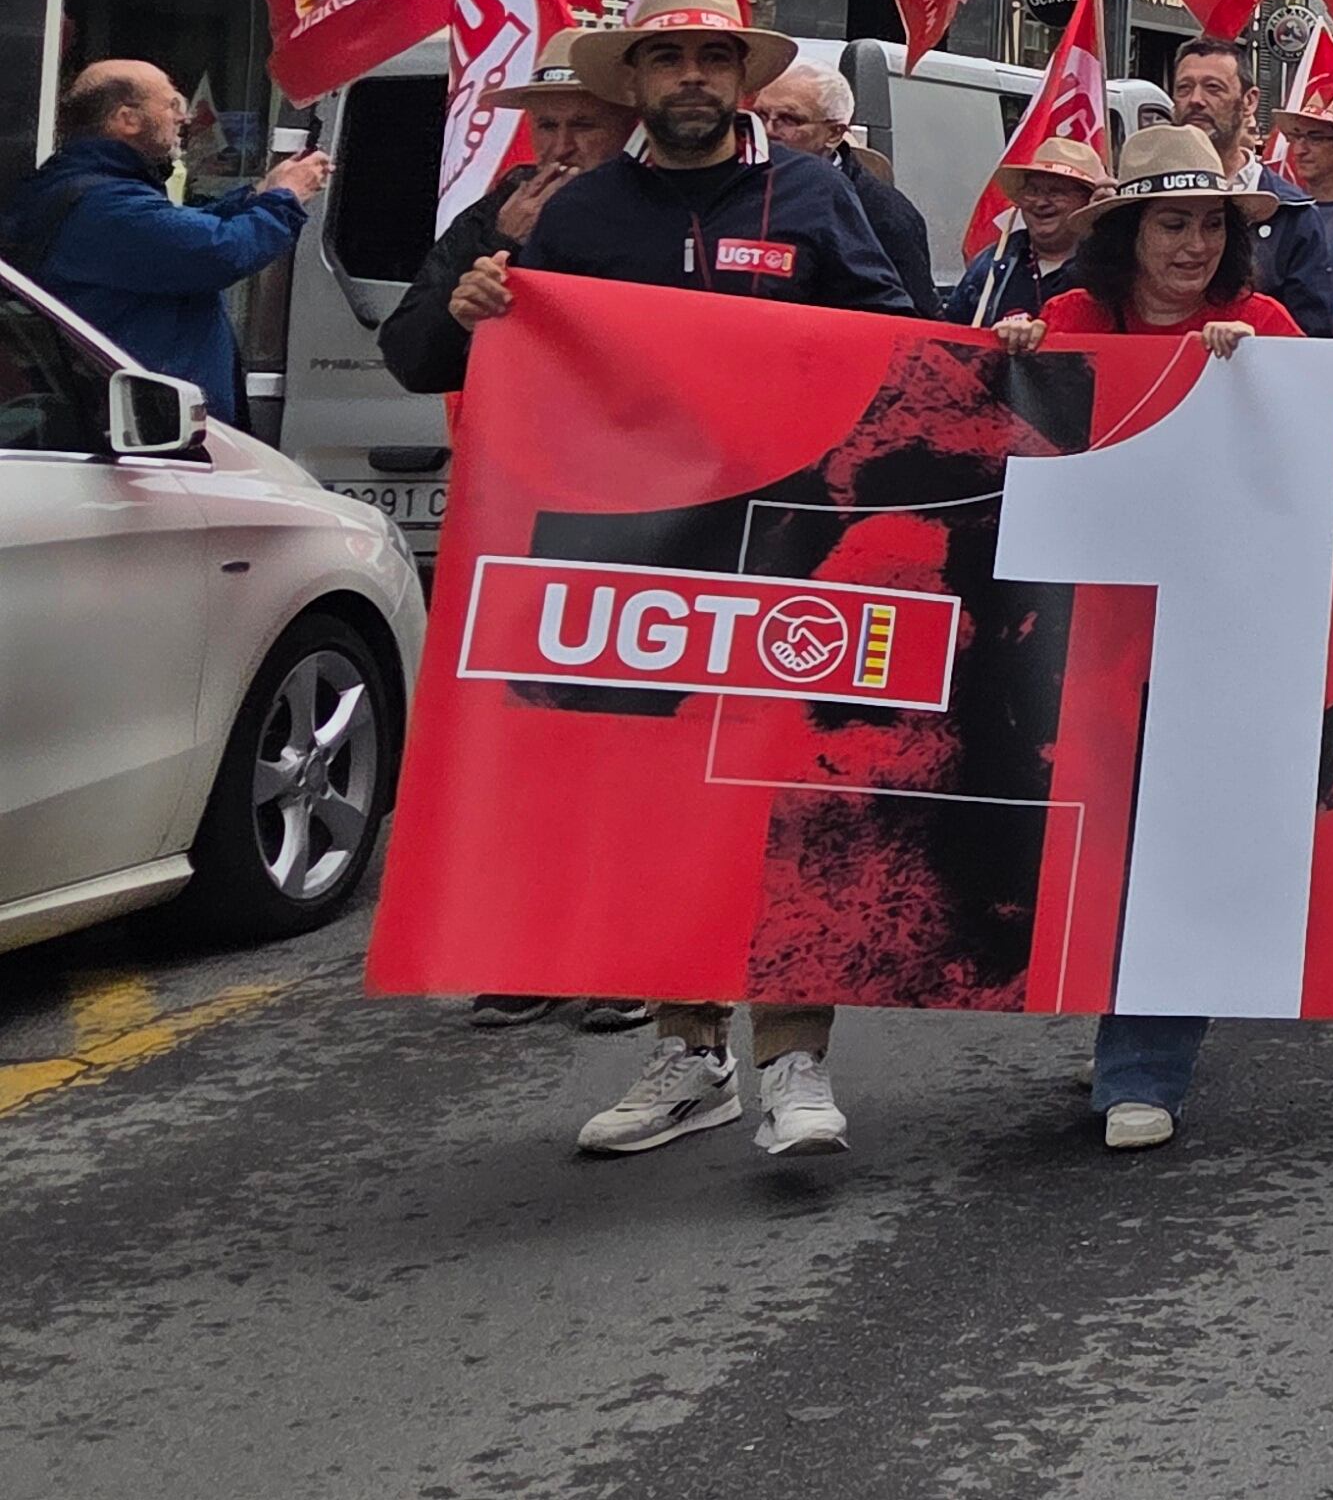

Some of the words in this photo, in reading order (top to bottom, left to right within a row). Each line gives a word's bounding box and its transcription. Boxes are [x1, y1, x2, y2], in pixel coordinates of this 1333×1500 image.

[1163, 173, 1196, 190] UGT
[718, 246, 765, 266] UGT
[536, 580, 762, 676] UGT
